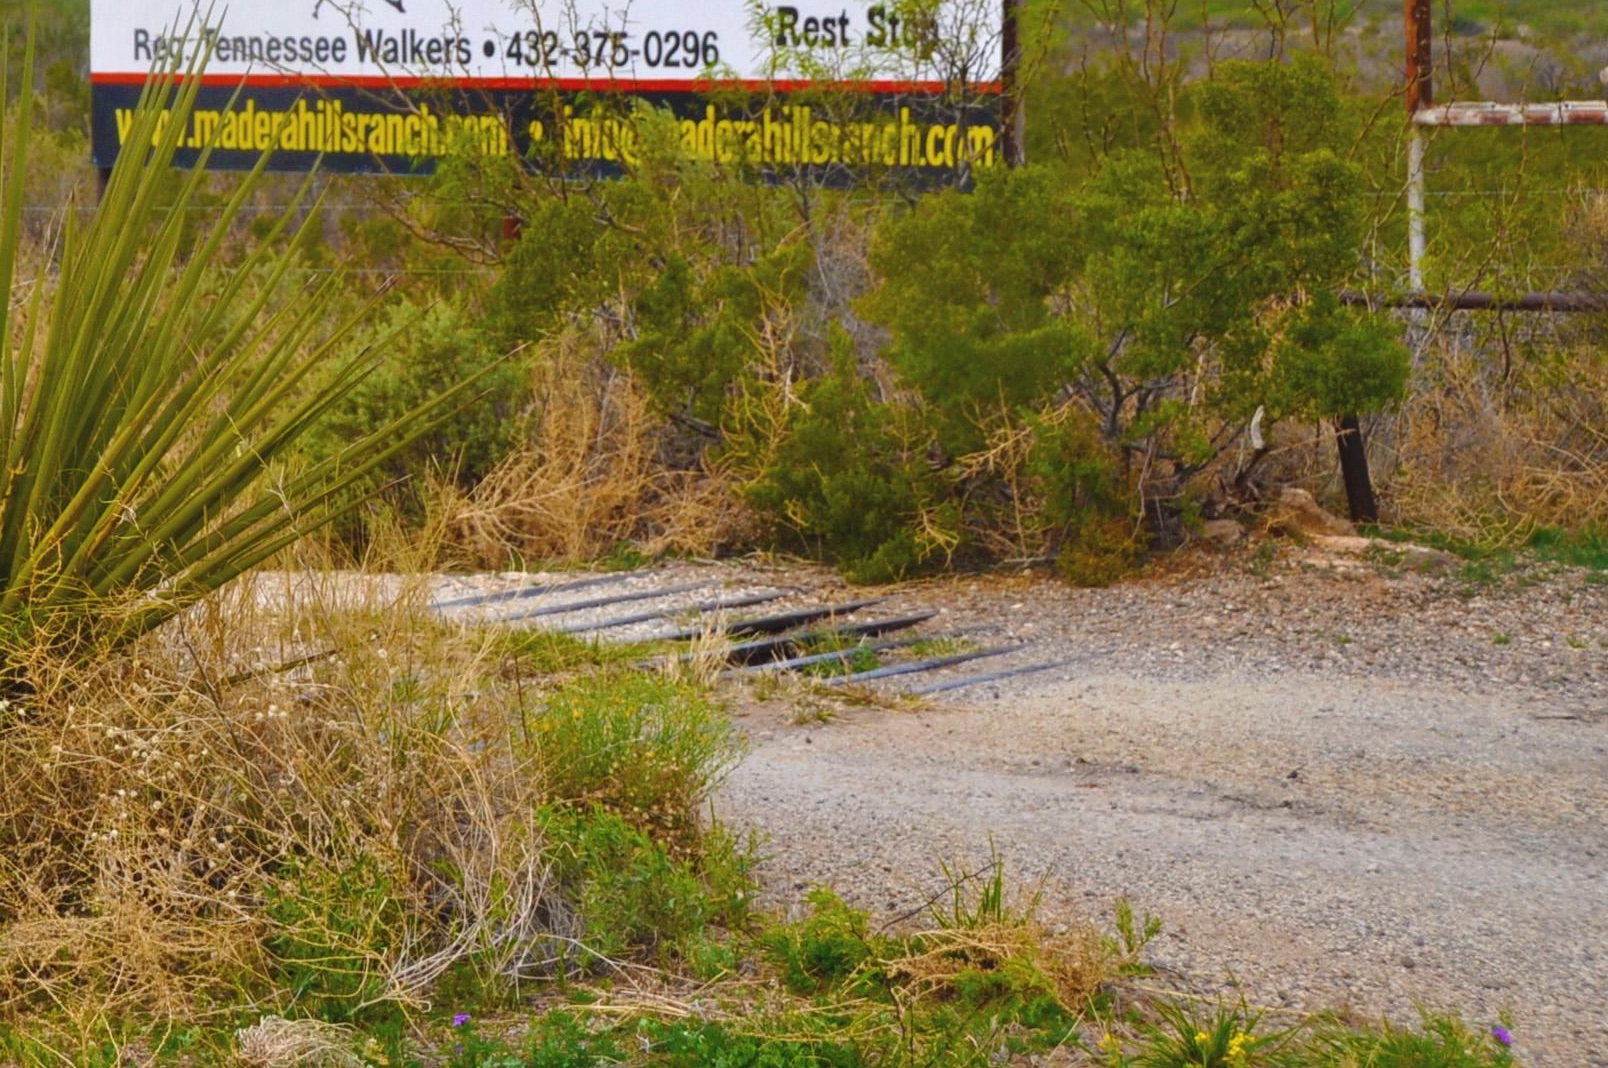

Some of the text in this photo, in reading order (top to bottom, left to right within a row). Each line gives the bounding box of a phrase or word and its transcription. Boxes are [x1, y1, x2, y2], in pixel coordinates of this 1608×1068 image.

[776, 6, 849, 48] Rest
[134, 28, 720, 69] Reg. Tennessee Walkers 432-375-0296
